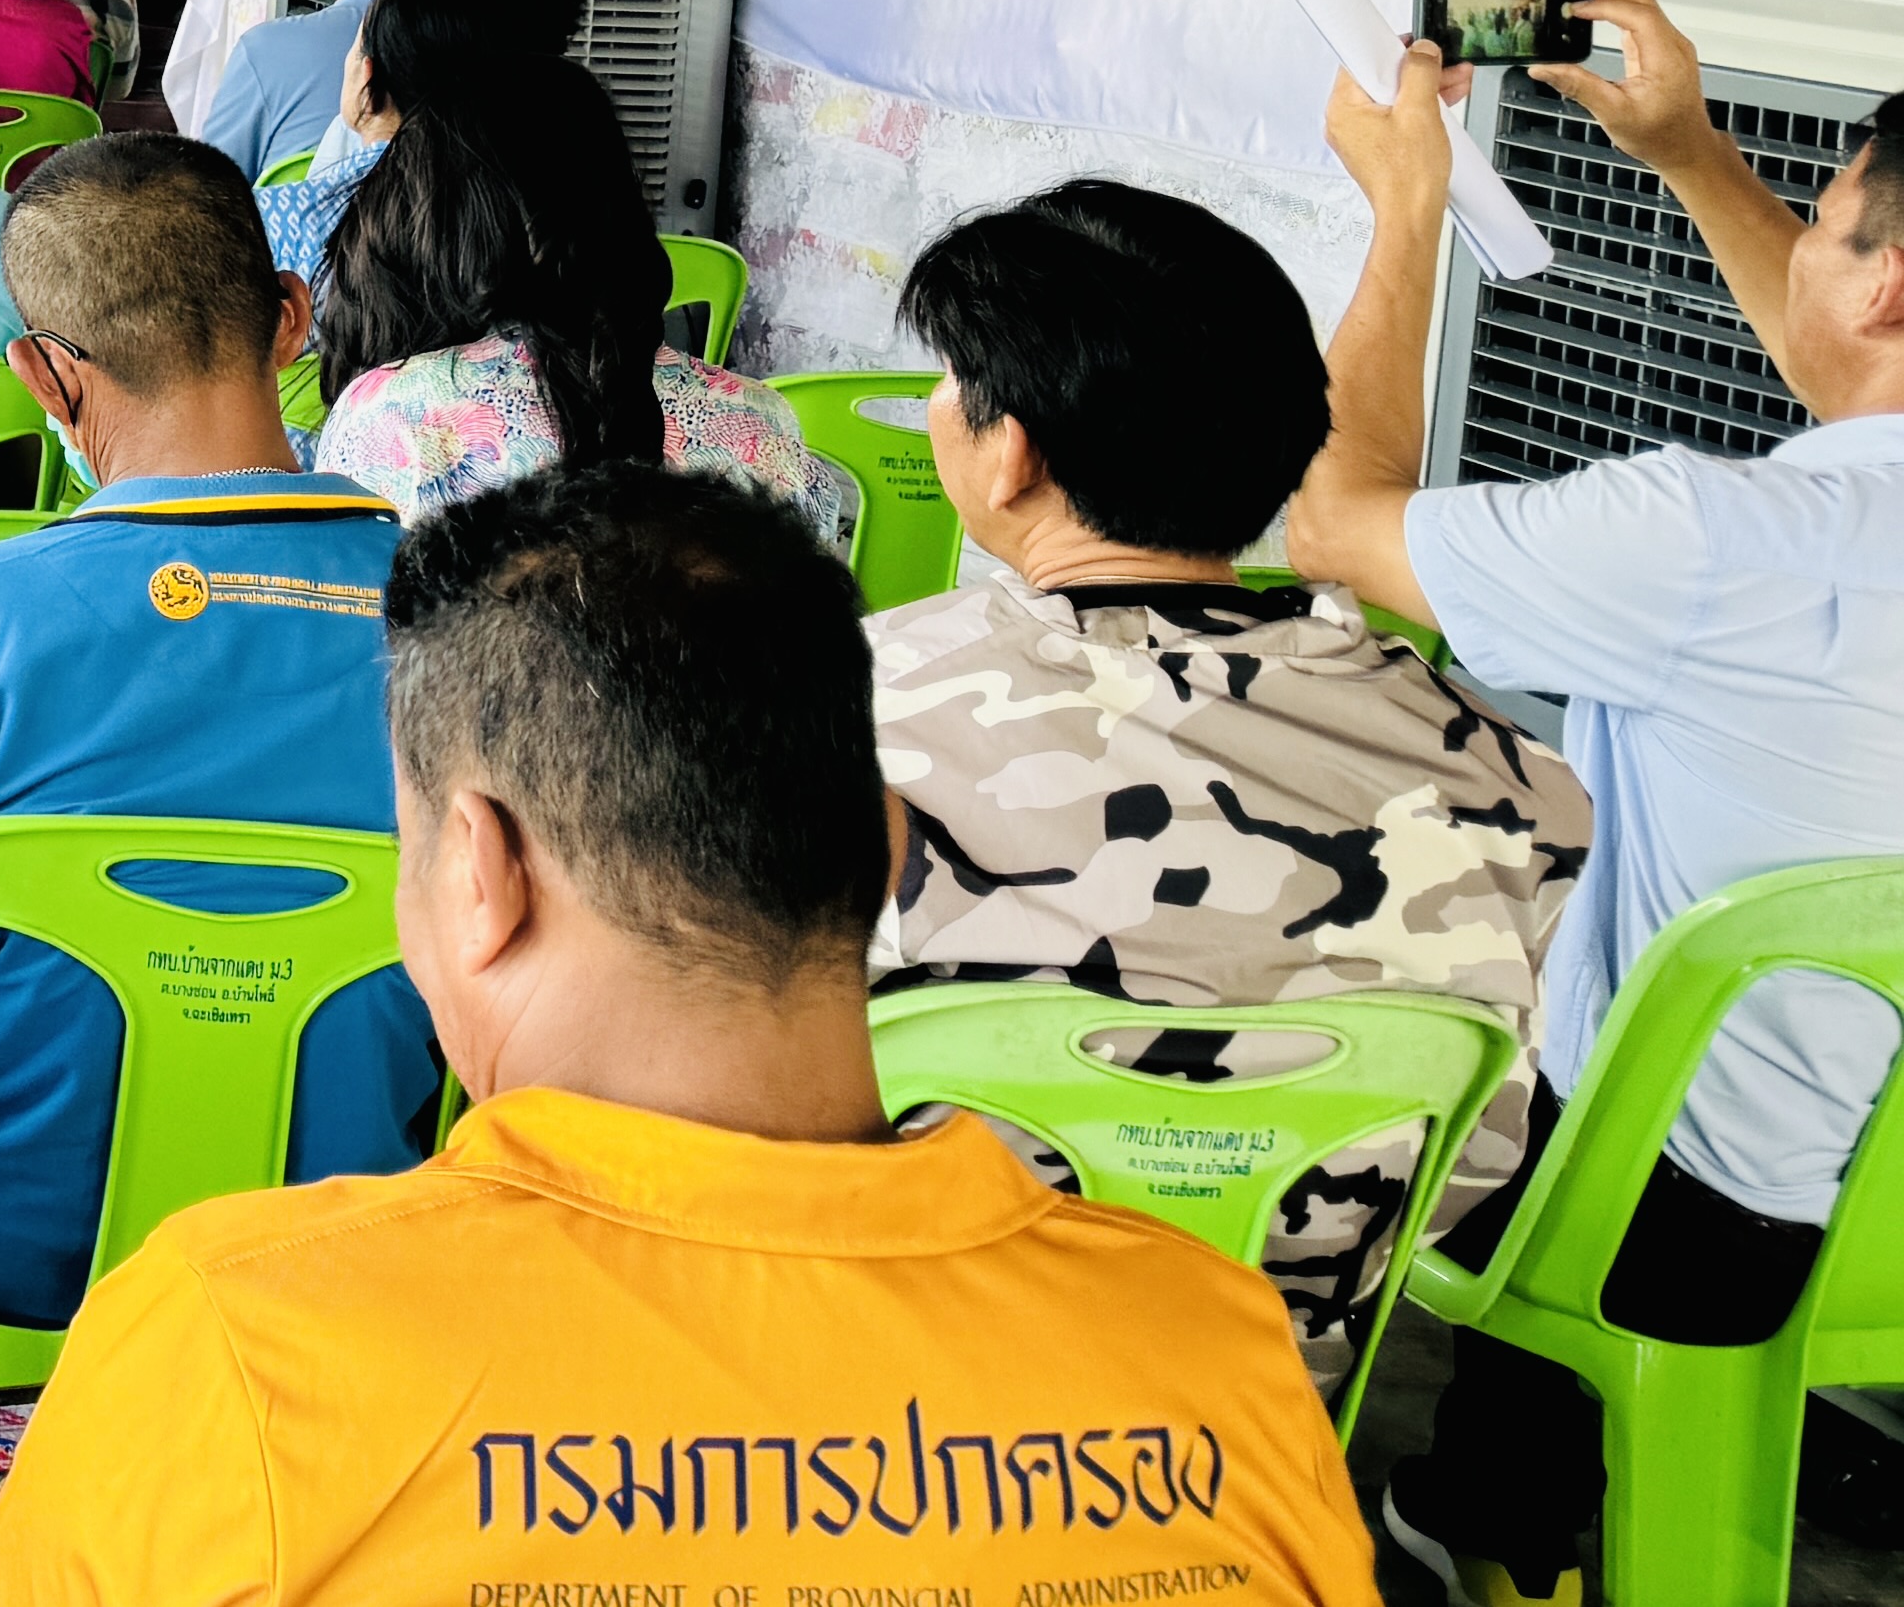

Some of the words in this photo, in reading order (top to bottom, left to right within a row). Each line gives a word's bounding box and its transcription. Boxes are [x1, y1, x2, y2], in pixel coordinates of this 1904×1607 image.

[147, 945, 264, 980] กทบ.บ้านจากแดง
[269, 958, 293, 982] ม.3
[1115, 1116, 1244, 1152] กทบ.บ้านจากแดง
[1248, 1128, 1276, 1153] ม.3
[468, 1396, 1225, 1536] กรมการปกครอง
[470, 1581, 688, 1607] DEPARTMENT
[714, 1584, 761, 1607] OF
[1016, 1562, 1252, 1607] ADMINISTRATION
